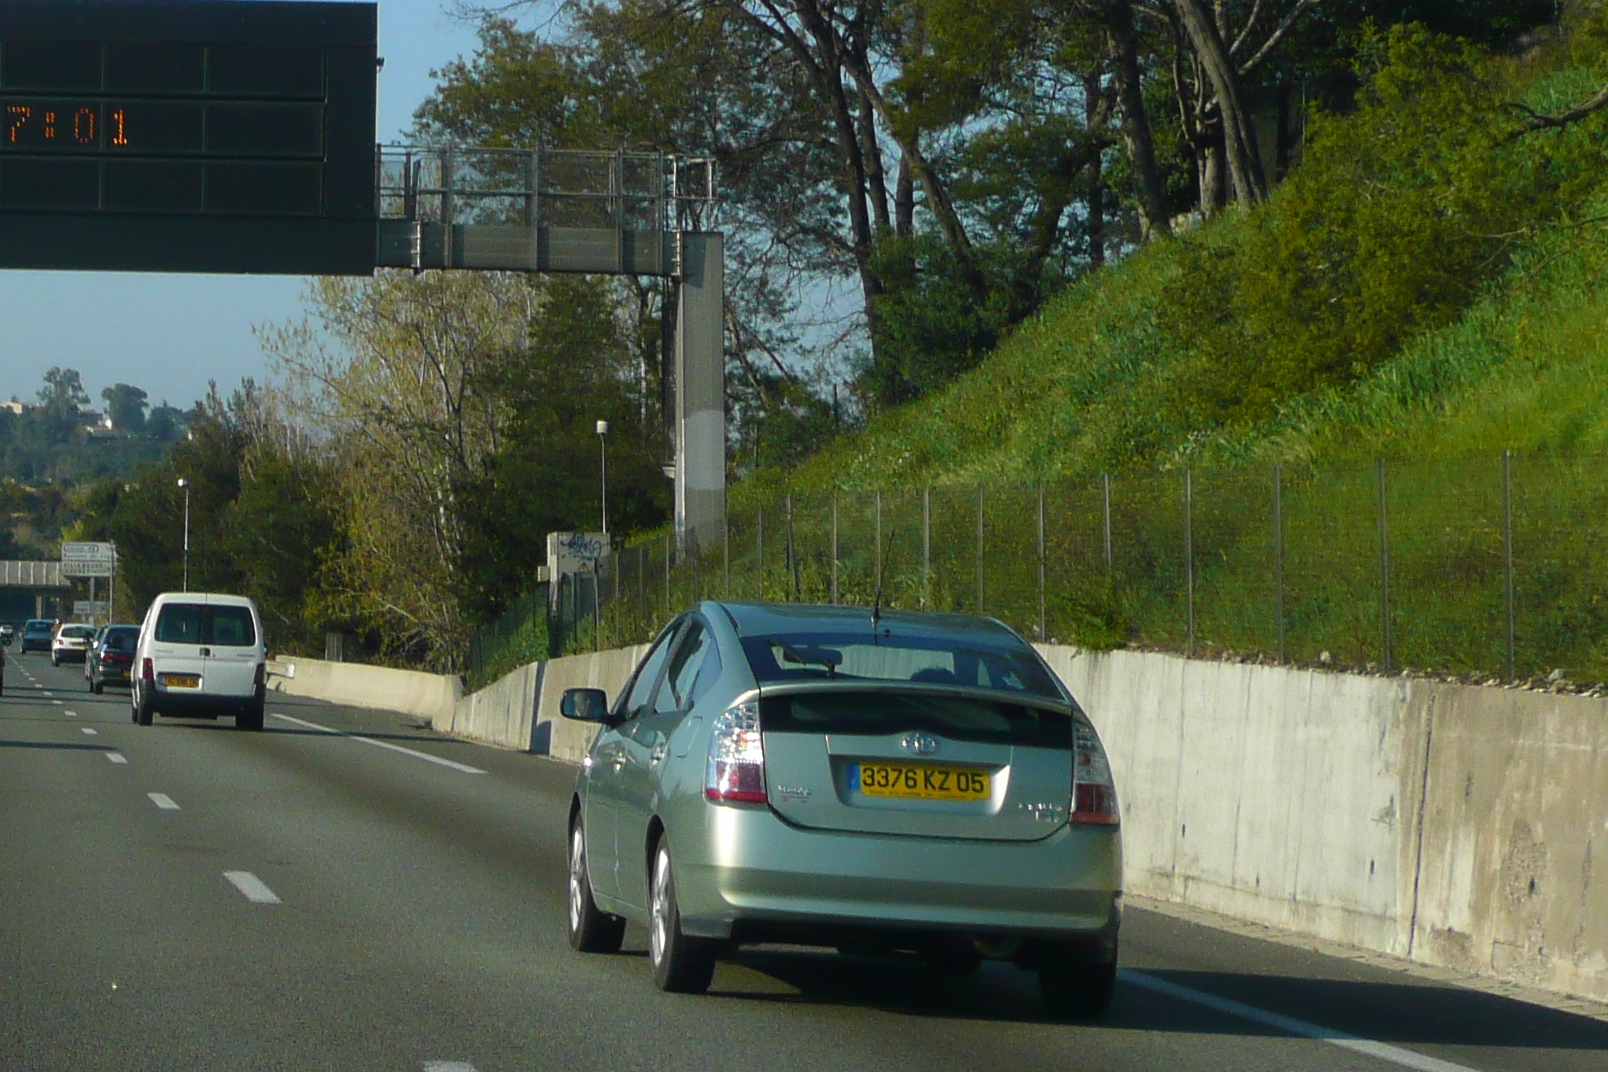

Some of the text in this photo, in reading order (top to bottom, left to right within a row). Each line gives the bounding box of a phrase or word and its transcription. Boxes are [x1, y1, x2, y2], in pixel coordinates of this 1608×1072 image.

[862, 766, 985, 794] 3376 KZ 05
